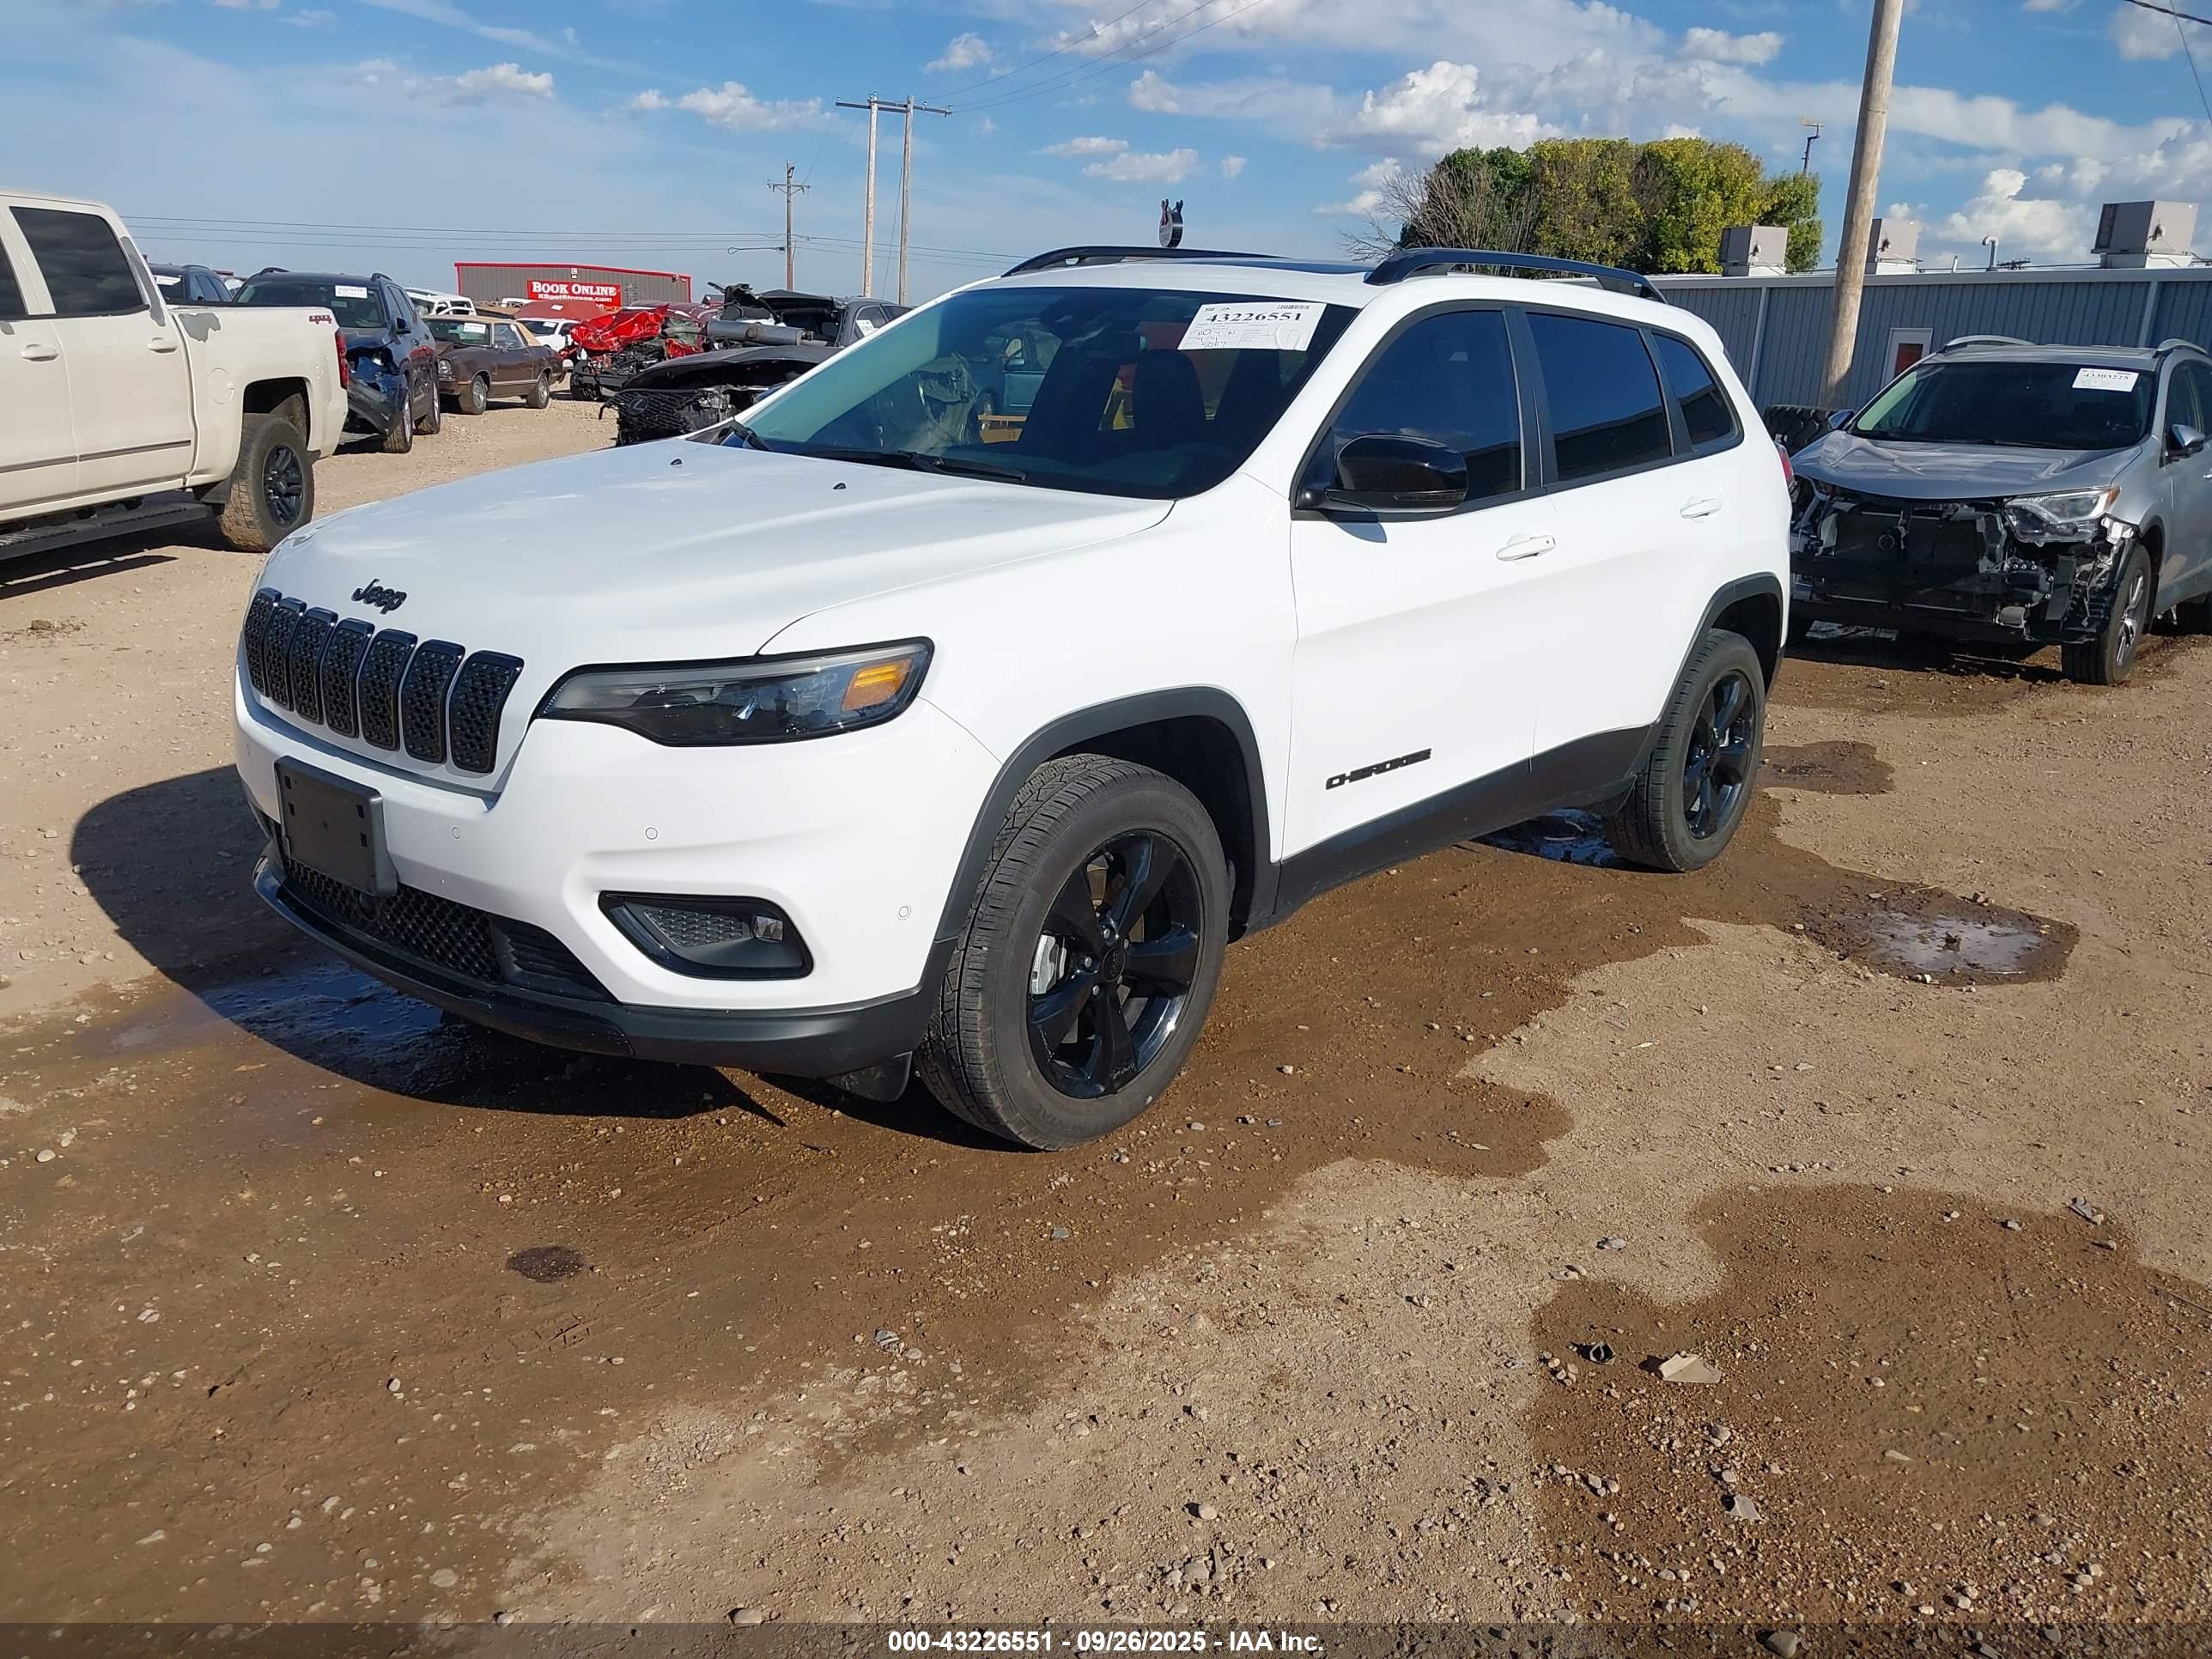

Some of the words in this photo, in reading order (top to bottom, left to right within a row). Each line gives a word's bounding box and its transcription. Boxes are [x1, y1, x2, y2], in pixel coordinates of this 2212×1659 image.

[532, 282, 568, 294] BOOK
[571, 284, 617, 296] ONLINE
[1205, 312, 1302, 323] 43226551
[351, 578, 407, 615] Jeep
